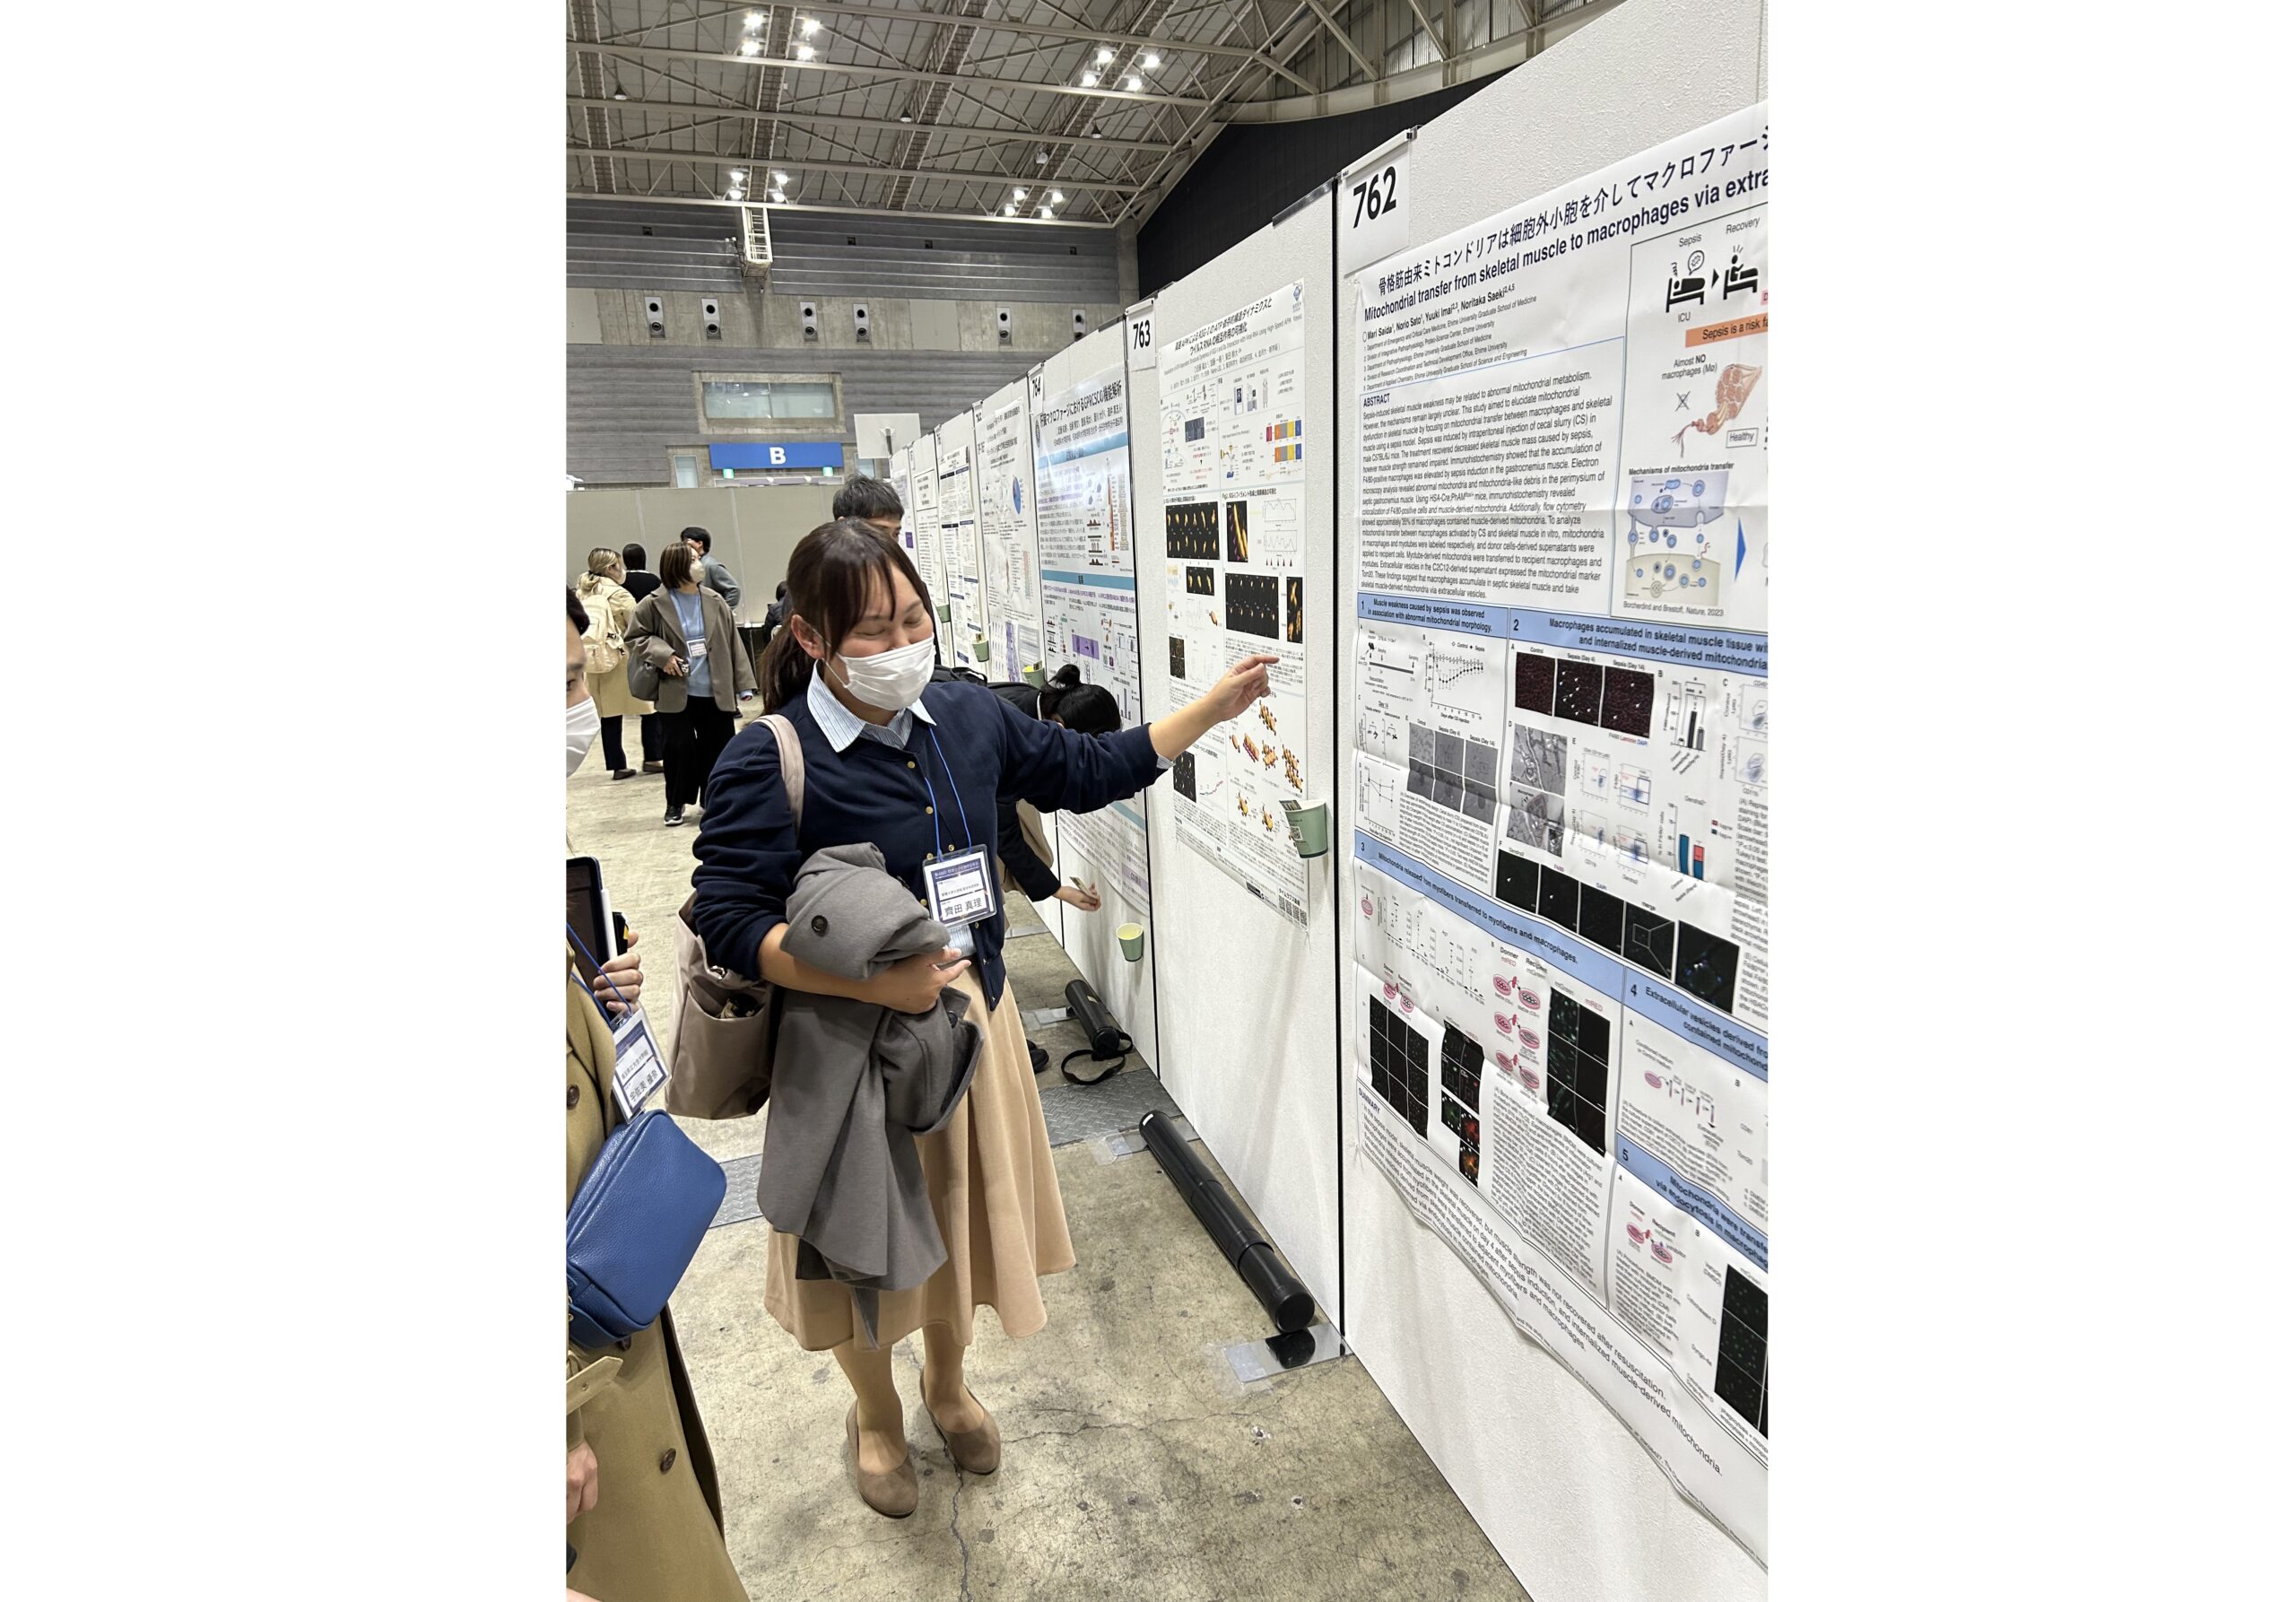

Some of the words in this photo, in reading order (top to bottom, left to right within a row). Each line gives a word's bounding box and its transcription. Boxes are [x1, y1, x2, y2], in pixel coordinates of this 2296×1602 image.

[1352, 166, 1397, 230] 762
[1726, 218, 1761, 234] Recovery
[1679, 233, 1702, 248] Sepsis
[1364, 289, 1416, 322] Mitochondrial
[1418, 280, 1452, 304] transfer
[1454, 274, 1476, 294] from
[1480, 257, 1519, 283] skeletal
[1523, 238, 1567, 266] muscle
[1570, 232, 1583, 250] to
[1587, 196, 1689, 245] macrophages
[1695, 184, 1719, 207] via
[1425, 310, 1440, 322] Yuuki
[1461, 295, 1485, 310] Noritaka
[1678, 312, 1691, 323] ICU
[1133, 319, 1151, 350] 763
[1702, 325, 1728, 340] Sepsis
[1730, 322, 1737, 332] is
[1738, 323, 1744, 332] a
[1745, 317, 1760, 331] risk
[1674, 358, 1694, 369] Almost
[1695, 354, 1706, 364] NO
[1661, 365, 1701, 379] macrophages
[1032, 376, 1040, 399] 764
[1487, 385, 1511, 398] abnormal
[1513, 377, 1551, 392] mitochondrial
[1552, 370, 1592, 386] metabolism.
[1363, 393, 1390, 407] ABSTRACT
[1488, 399, 1504, 409] aimed
[1505, 398, 1510, 407] to
[1511, 393, 1536, 405] elucidate
[1538, 387, 1580, 402] mitochondrial
[1504, 407, 1527, 421] between
[1529, 403, 1570, 418] macrophages
[1572, 400, 1584, 411] and
[1586, 396, 1613, 409] skeletal
[1506, 422, 1528, 435] injection
[1530, 421, 1535, 431] of
[1536, 418, 1552, 430] cecal
[1553, 416, 1571, 429] slurry
[1573, 414, 1587, 427] (CS)
[1589, 414, 1596, 423] in
[1522, 437, 1536, 446] mass
[1538, 431, 1561, 443] caused
[1561, 431, 1569, 443] by
[1570, 429, 1593, 442] sepsis,
[1729, 431, 1754, 442] Healthy
[770, 447, 786, 464] B
[1552, 442, 1593, 456] accumulation
[1595, 441, 1602, 452] of
[1571, 457, 1599, 468] Electron
[1629, 466, 1663, 475] Mechanisms
[1664, 466, 1670, 474] of
[1671, 463, 1709, 473] mitochondria
[1710, 462, 1735, 471] transfer
[1560, 473, 1596, 484] perimysium
[1597, 471, 1605, 481] of
[1543, 501, 1554, 511] flow
[1556, 502, 1587, 513] cytometry
[1361, 600, 1365, 611] 1
[1373, 598, 1387, 607] Muscle
[1387, 600, 1408, 610] weakness
[1409, 602, 1425, 612] caused
[1426, 604, 1432, 614] by
[1433, 605, 1450, 615] sepsis
[1451, 607, 1460, 616] was
[1461, 608, 1485, 619] observed
[1653, 603, 1662, 612] and
[1708, 608, 1724, 617] 2023
[1372, 608, 1395, 618] association
[1396, 610, 1405, 619] with
[1405, 613, 1425, 623] abnormal
[1426, 615, 1460, 627] mitochondrial
[1461, 620, 1492, 633] morphology.
[1513, 619, 1519, 631] 2
[1550, 618, 1594, 633] Macrophages
[1596, 624, 1643, 638] accumulated
[1645, 629, 1652, 639] in
[1654, 631, 1686, 644] skeletal
[1688, 635, 1724, 648] muscle
[1726, 638, 1752, 651] tissue
[1530, 646, 1544, 655] Control
[1579, 636, 1592, 645] and
[1595, 637, 1637, 651] internalized
[1639, 643, 1702, 661] muscle-derived
[1361, 841, 1365, 852] 3
[1404, 866, 1422, 882] released
[1455, 895, 1482, 916] transferred
[1482, 910, 1488, 919] to
[1488, 915, 1518, 935] myofibers
[1519, 928, 1533, 940] and
[1534, 936, 1578, 964] macrophages.
[1500, 946, 1519, 959] Donner
[1631, 984, 1638, 997] 4
[1646, 987, 1689, 1018] Extracellular
[1690, 1013, 1721, 1034] vesicles
[1723, 1026, 1754, 1051] derived
[1683, 1021, 1721, 1047] contained
[1359, 1087, 1380, 1114] SUMMARY
[1622, 1148, 1629, 1162] 5
[1656, 1180, 1667, 1192] via
[1668, 1188, 1714, 1226] endocytosis
[1715, 1219, 1723, 1232] in
[1720, 1212, 1738, 1232] were
[1513, 1253, 1537, 1278] strength
[1539, 1275, 1551, 1291] was
[1552, 1289, 1561, 1302] not
[1563, 1300, 1596, 1335] recovered
[1596, 1332, 1613, 1351] after
[1614, 1349, 1665, 1400] resuscitation.
[1529, 1291, 1542, 1306] and
[1543, 1303, 1586, 1352] macrophages.
[1527, 1276, 1557, 1310] induction,
[1559, 1307, 1570, 1323] and
[1572, 1319, 1611, 1362] internalized
[1611, 1359, 1672, 1418] muscle-derived
[1671, 1415, 1723, 1476] mitochondria.
